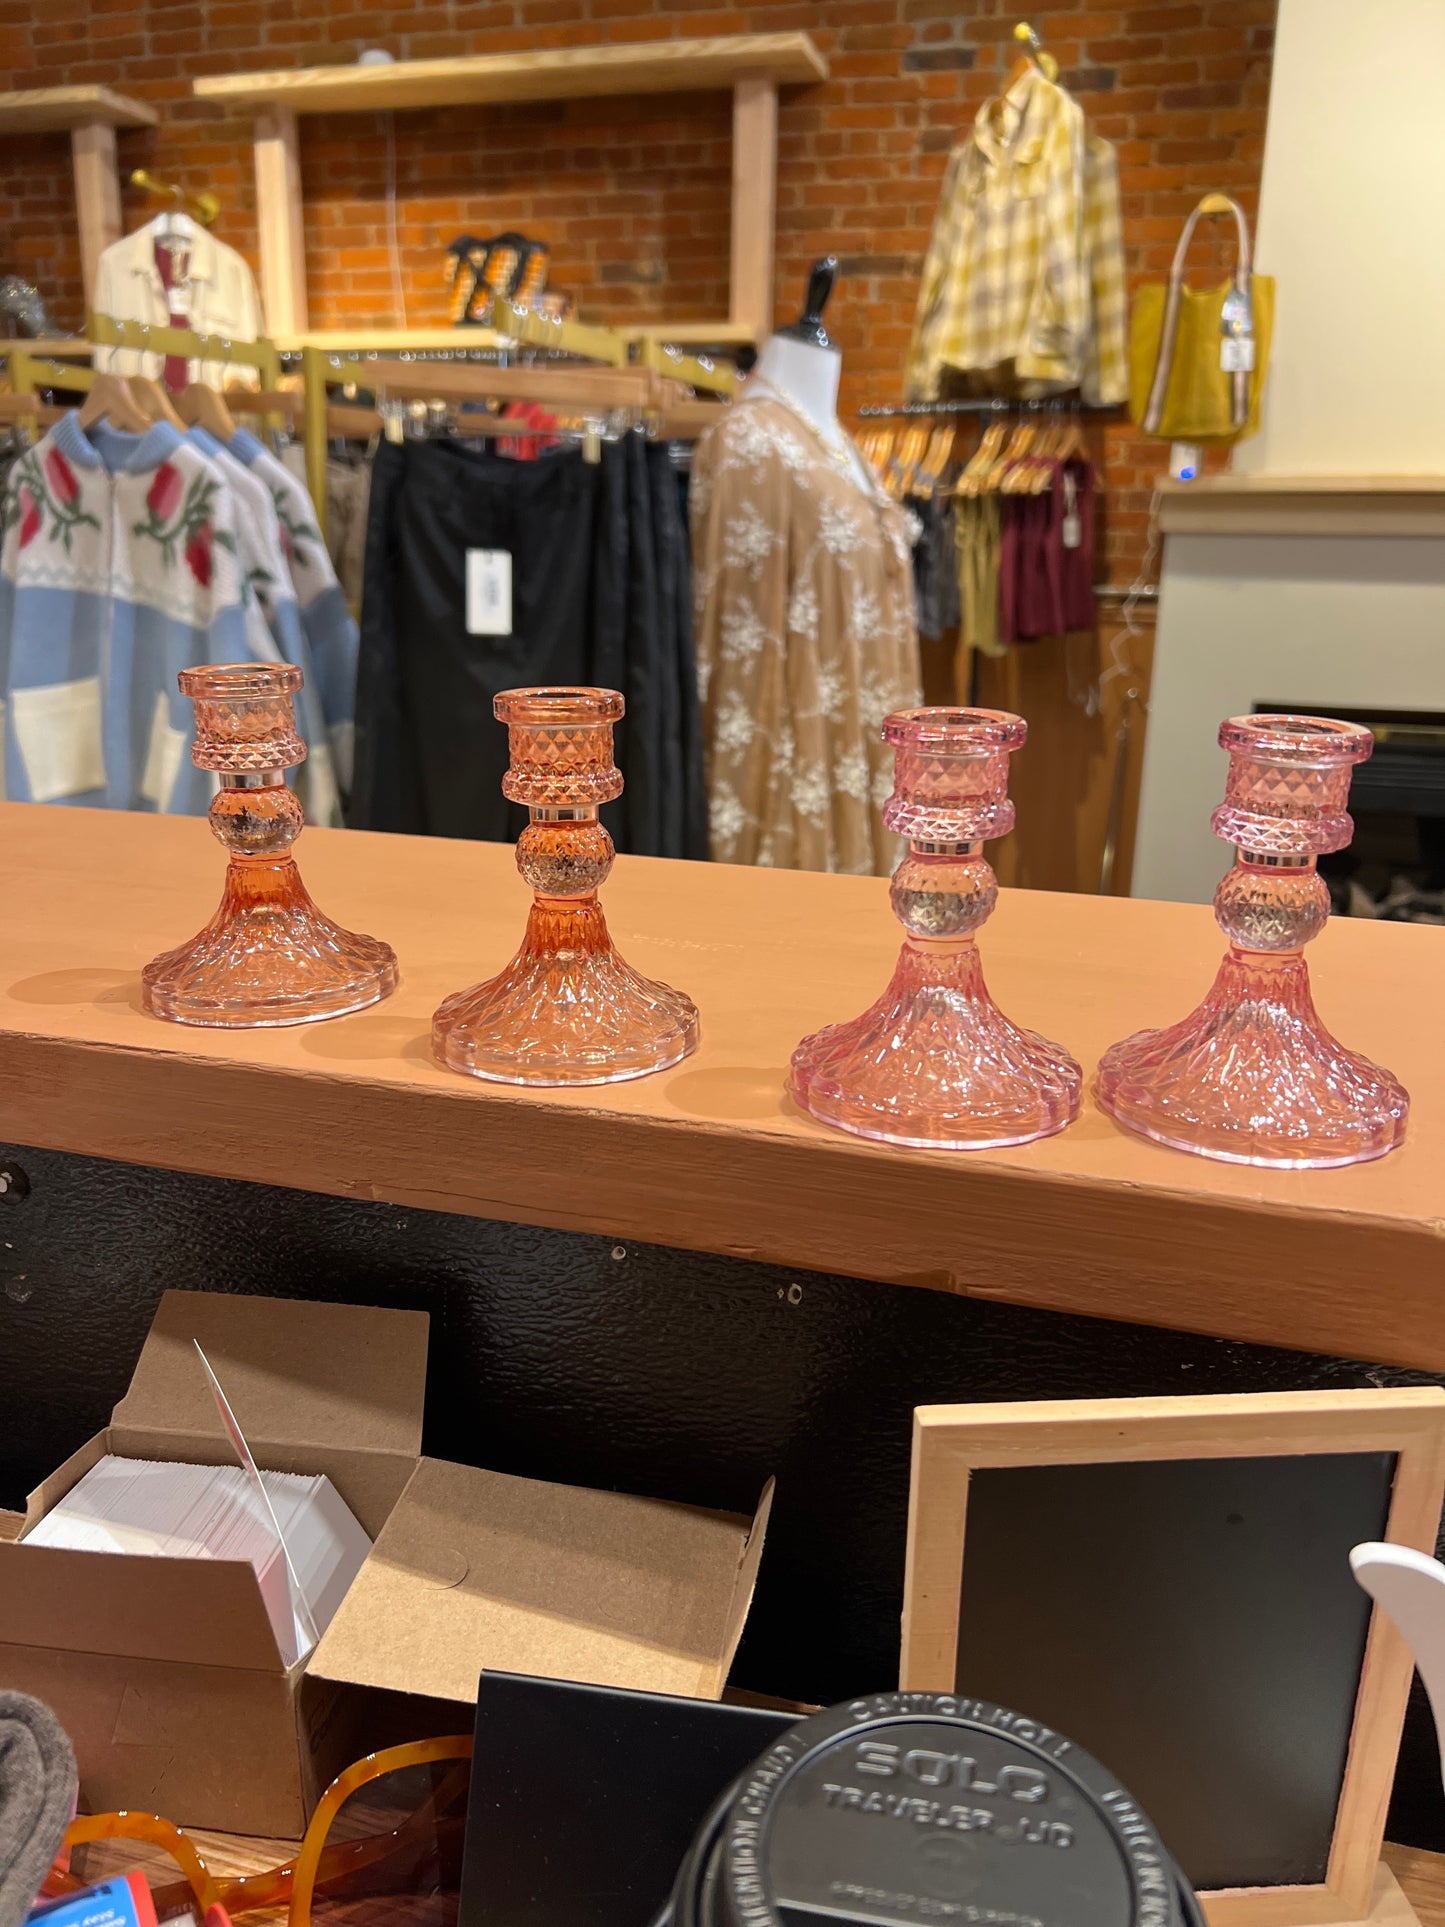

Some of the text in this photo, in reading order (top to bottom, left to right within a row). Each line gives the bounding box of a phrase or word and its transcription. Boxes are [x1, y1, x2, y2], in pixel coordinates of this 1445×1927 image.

[848, 1693, 984, 1721] CAUTION
[855, 1741, 1048, 1802] SOLO
[821, 1783, 1075, 1849] TRAVELER LID
